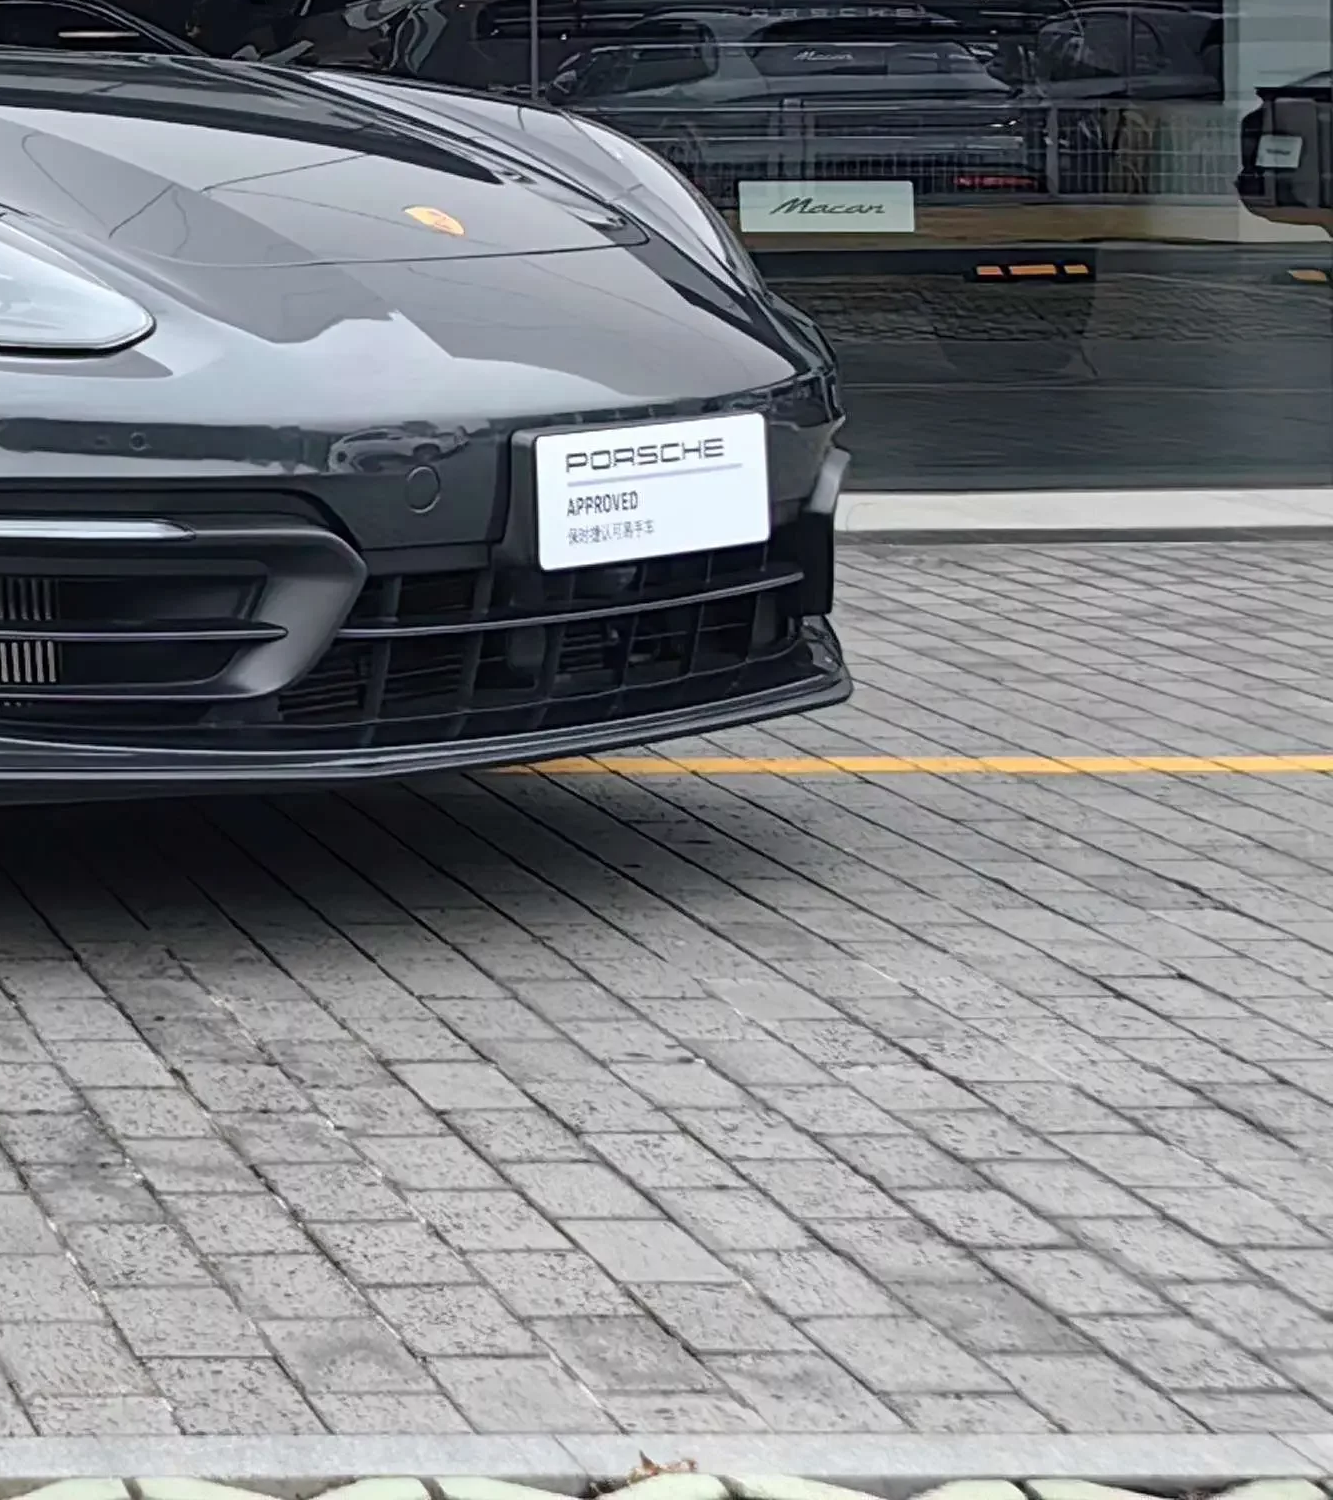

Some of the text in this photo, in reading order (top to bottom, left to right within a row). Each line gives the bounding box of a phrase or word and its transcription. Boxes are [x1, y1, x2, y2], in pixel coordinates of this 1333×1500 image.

[769, 197, 886, 215] Macan
[566, 438, 725, 473] PORSCHE
[567, 490, 639, 516] APPROVED
